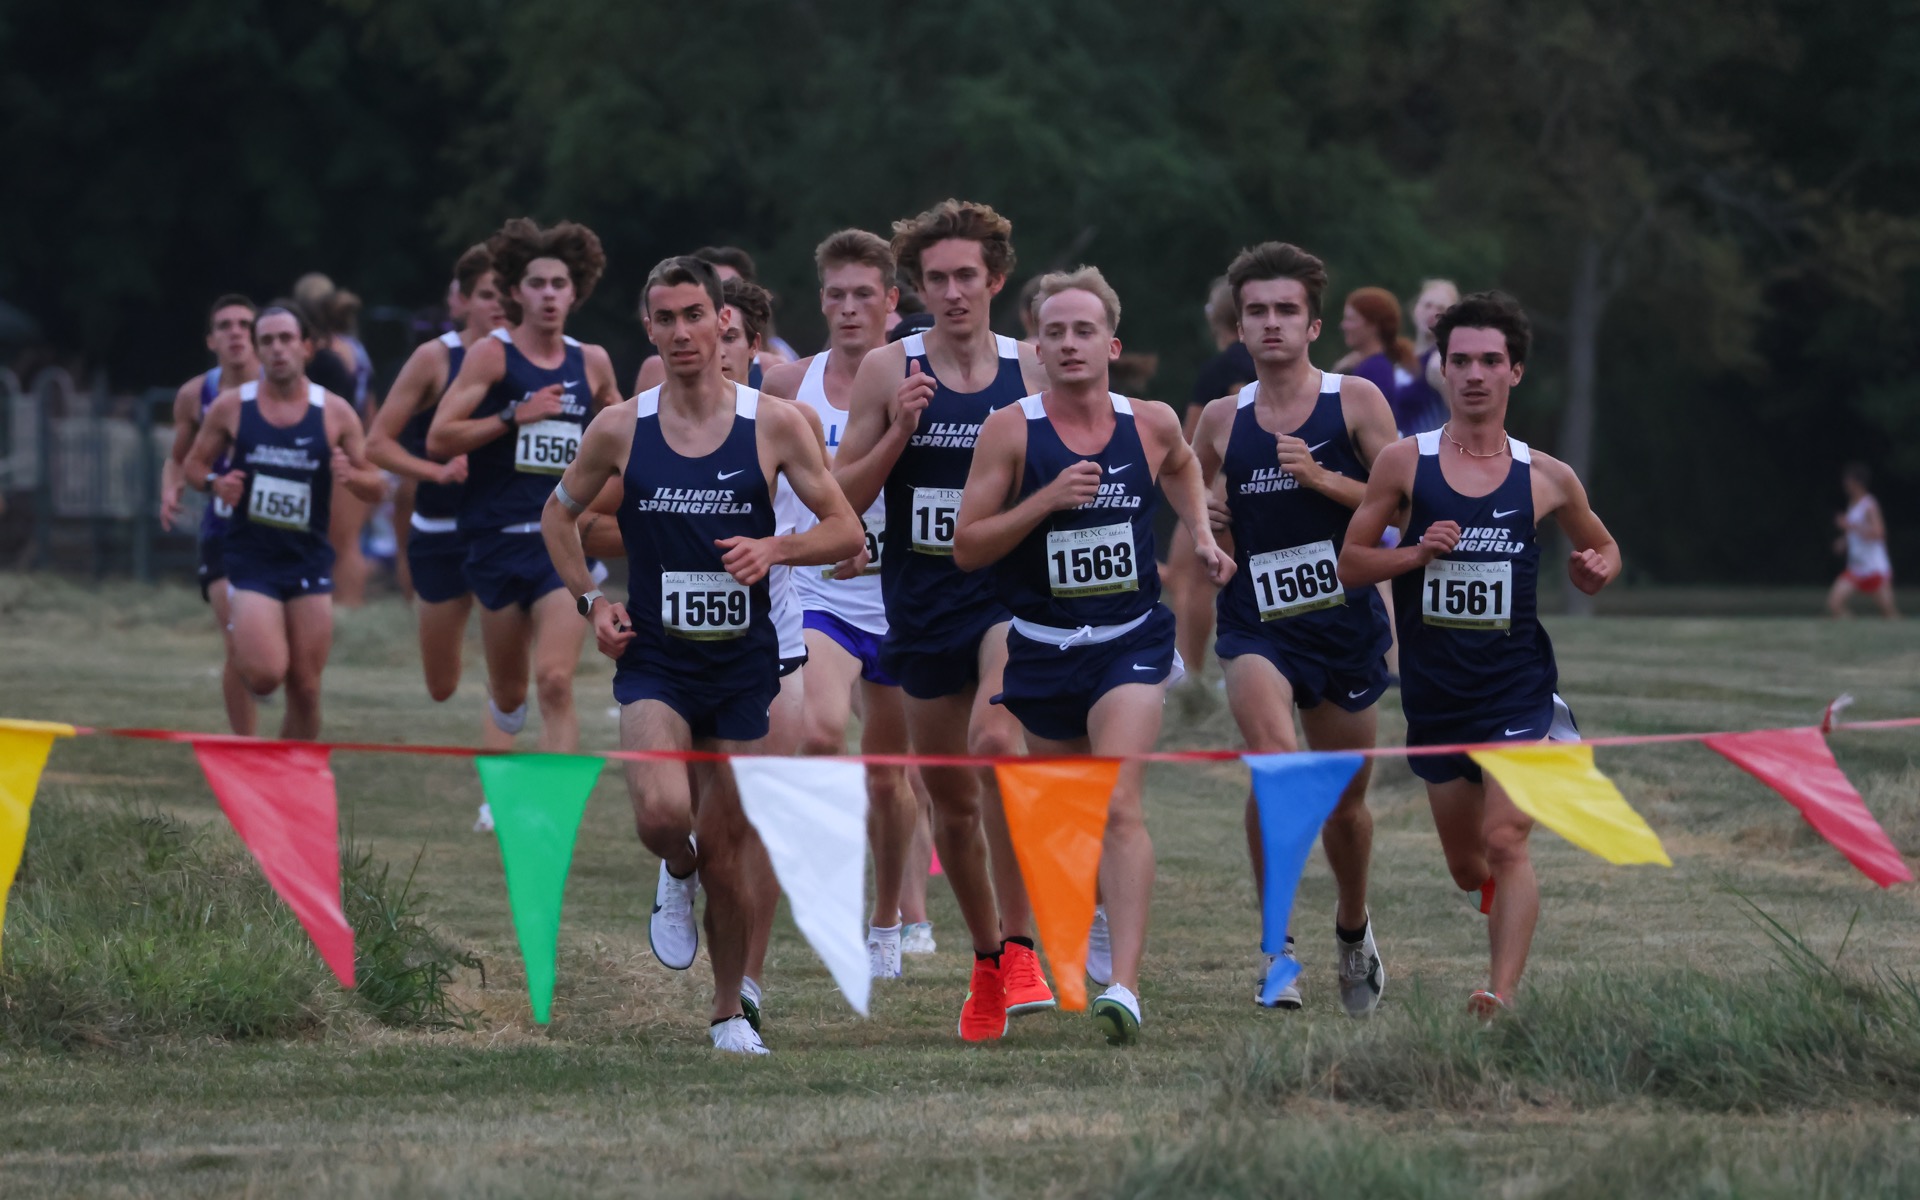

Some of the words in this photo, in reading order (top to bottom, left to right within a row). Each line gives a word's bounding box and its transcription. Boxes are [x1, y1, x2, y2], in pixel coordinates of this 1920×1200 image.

[928, 423, 981, 435] ILLIN
[911, 434, 977, 448] SPRING
[521, 434, 578, 465] 1556
[1240, 478, 1299, 495] SPRING
[653, 487, 735, 502] ILLINOIS
[255, 490, 306, 519] 1554
[638, 499, 752, 514] SPRINGFIELD
[916, 506, 960, 542] 15
[1071, 527, 1107, 540] TRXC
[1271, 546, 1308, 561] TRXC
[1453, 540, 1524, 553] NGFIELD
[1052, 542, 1133, 585] 1563
[1448, 562, 1486, 572] TRXC
[687, 573, 724, 582] TRXC
[1257, 559, 1339, 607] 1569
[1427, 578, 1503, 616] 1561
[666, 590, 747, 627] 1559
